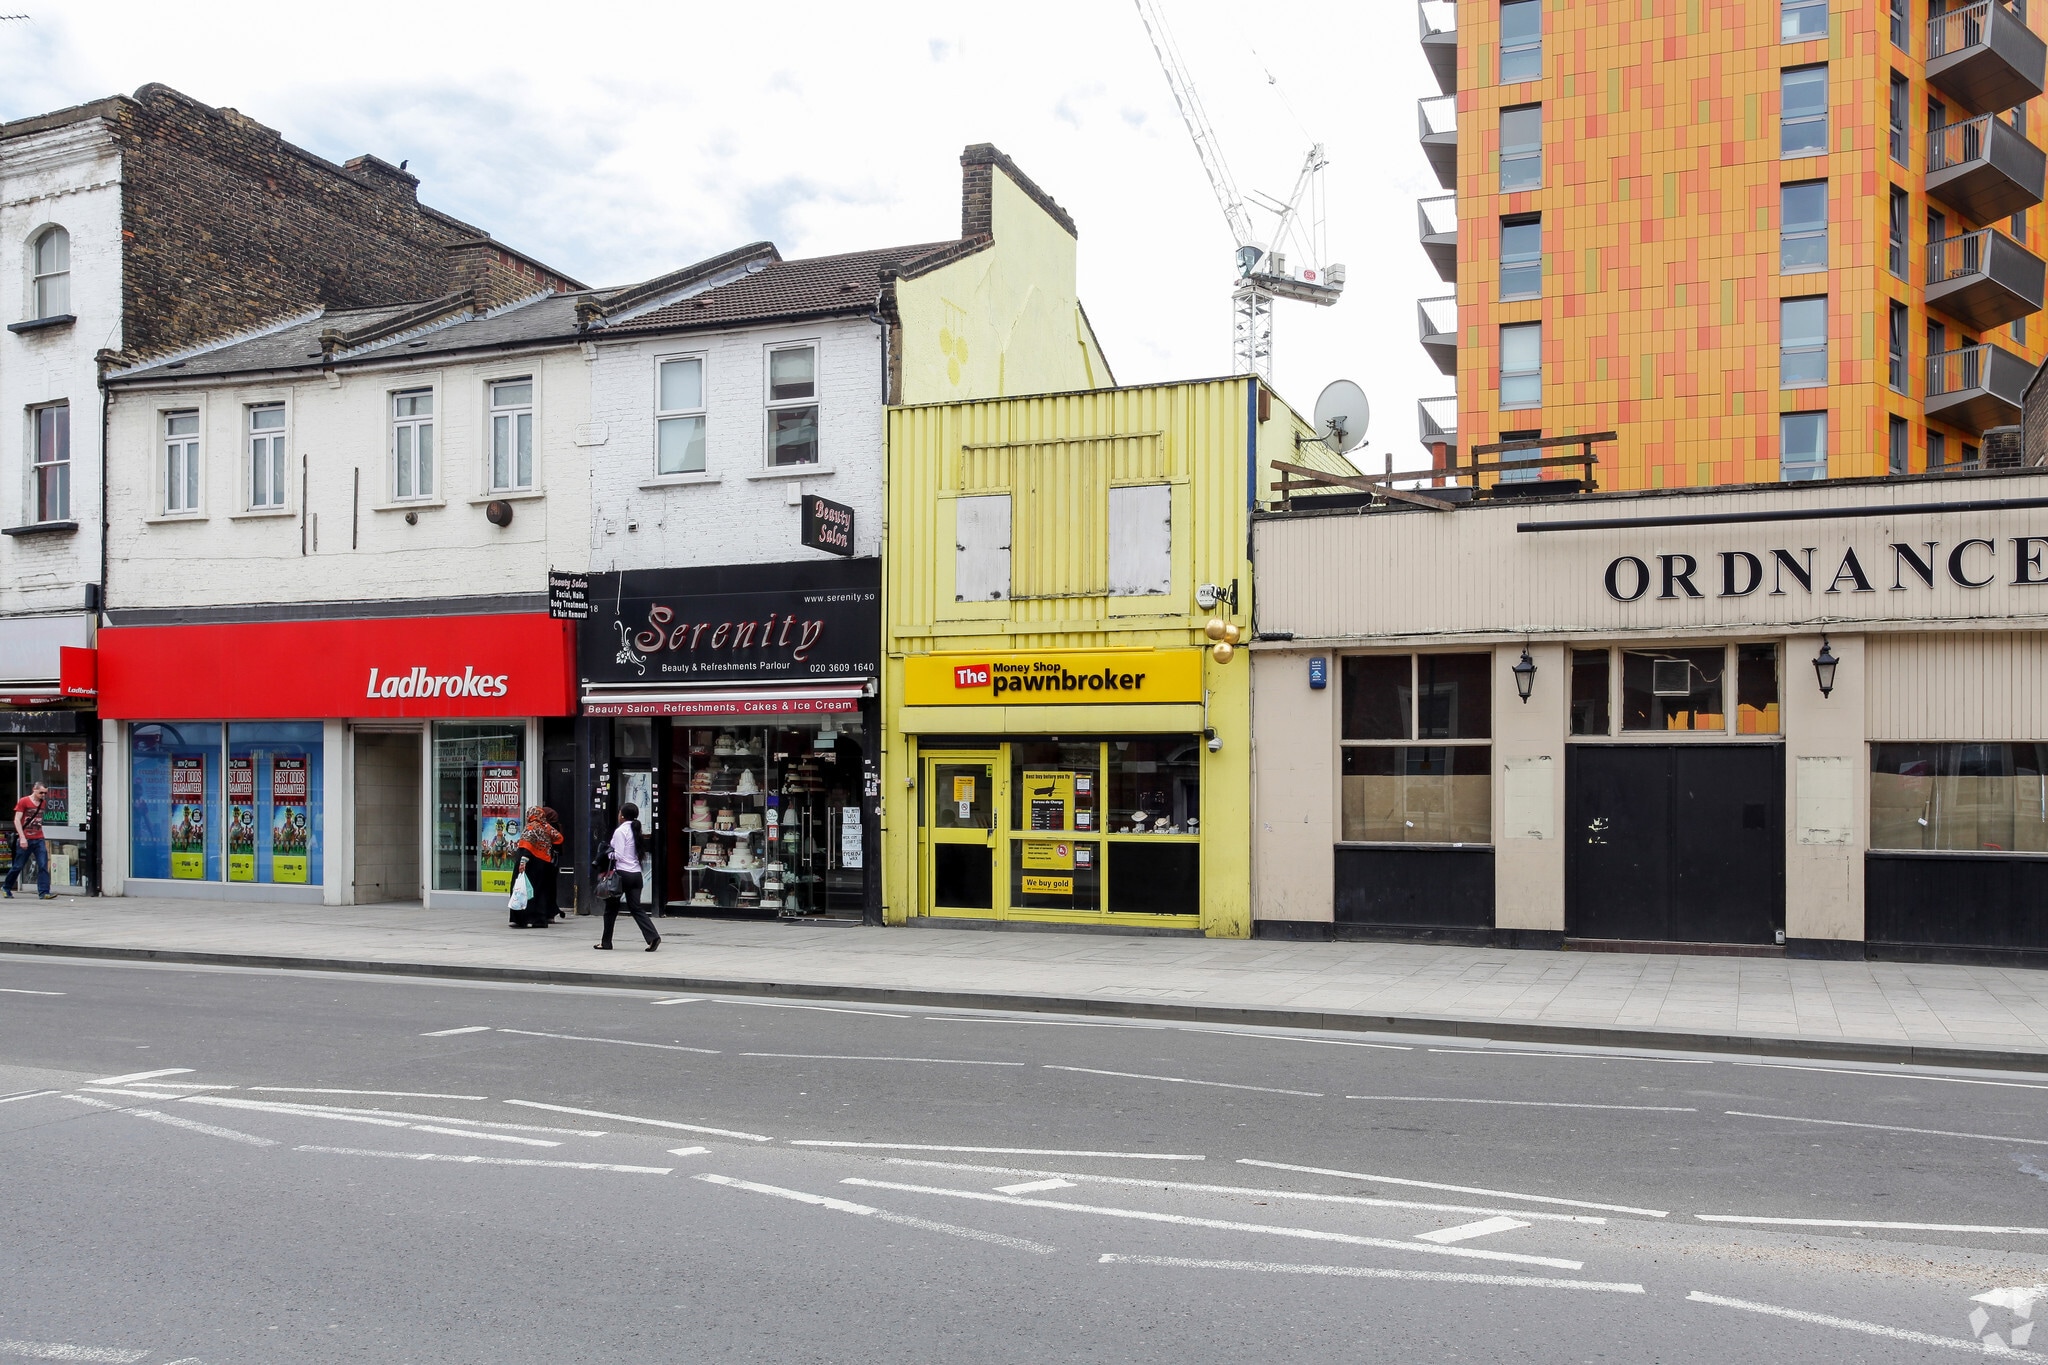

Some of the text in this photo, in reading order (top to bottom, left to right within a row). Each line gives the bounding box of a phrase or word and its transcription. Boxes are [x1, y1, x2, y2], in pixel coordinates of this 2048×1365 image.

[815, 500, 851, 532] Beauty
[818, 524, 848, 547] Salon
[1603, 535, 2048, 602] ORDNANCE
[550, 577, 588, 589] Beauty Salon
[556, 590, 584, 600] Facial, Nails
[804, 593, 875, 603] www.serenity.so
[551, 599, 588, 609] Body Treatments
[553, 609, 588, 619] & Hair Removal
[634, 602, 825, 662] Serenity
[661, 661, 791, 673] Beauty & Refreshments Parlour
[810, 662, 875, 673] 020 3609 1640
[993, 661, 1061, 674] Money Shop
[366, 665, 509, 698] Ladbrokes
[957, 669, 988, 685] The
[993, 668, 1146, 697] pawnbroker
[588, 700, 852, 714] Beauty Salon, Refreshments, Cakes & Ice Cream
[184, 759, 188, 768] 2
[234, 760, 238, 769] 2
[286, 760, 291, 769] 2
[173, 771, 187, 782] BEST
[187, 771, 202, 782] ODDS
[236, 771, 252, 783] ODDS
[275, 771, 305, 783] BEST ODDS
[497, 768, 502, 778] 2
[173, 782, 202, 793] GUARANTEED
[274, 783, 305, 794] GUARANTEED
[483, 781, 519, 793] BEST ODDS
[483, 793, 519, 805] GUARANTEED
[47, 800, 65, 810] SPA
[44, 811, 69, 821] WAXING
[1038, 879, 1051, 888] buy
[1053, 880, 1069, 888] gold
